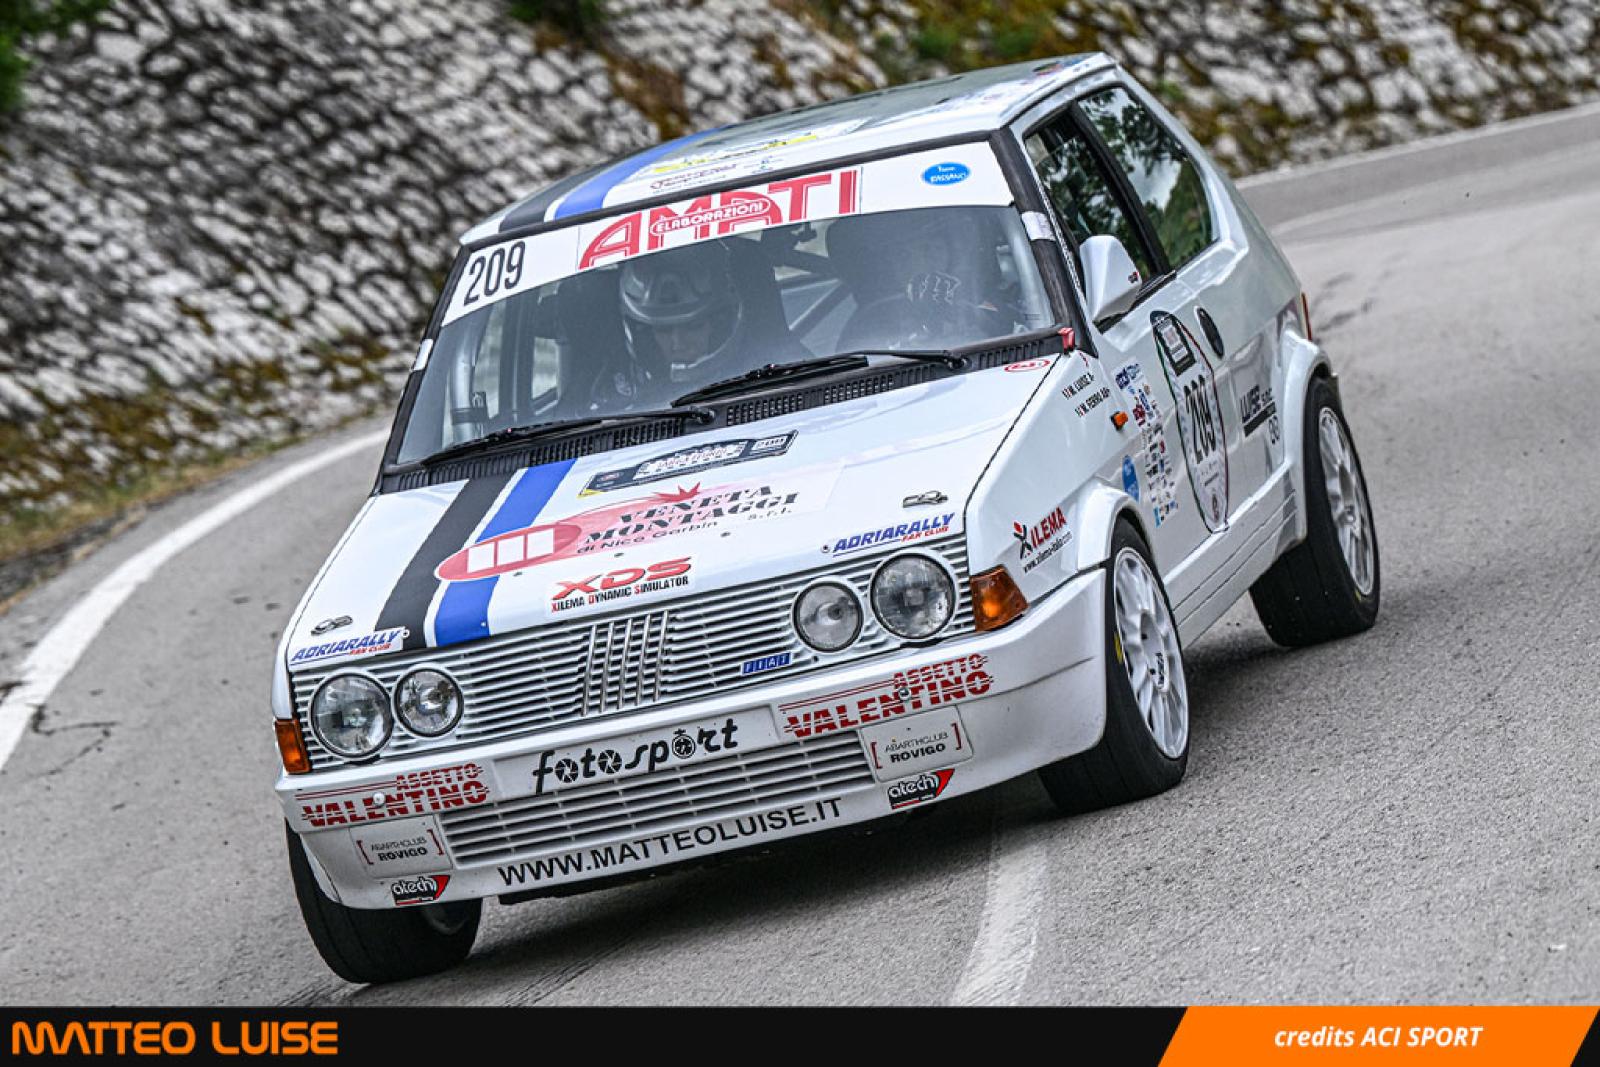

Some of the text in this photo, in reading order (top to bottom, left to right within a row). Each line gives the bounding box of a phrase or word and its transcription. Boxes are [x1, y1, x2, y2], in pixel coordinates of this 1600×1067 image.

[578, 169, 858, 271] AMATI
[655, 202, 764, 234] ELABORAZIONI
[463, 241, 526, 306] 209
[1183, 374, 1217, 464] 209
[585, 492, 798, 545] MONTAGGI
[620, 485, 773, 523] VENETA
[601, 536, 645, 549] Nico
[652, 520, 718, 539] Garbin
[832, 512, 956, 553] ADRIARALLY
[1013, 507, 1067, 559] XILEMA
[550, 556, 692, 601] XDS
[551, 575, 690, 613] XILEMA DYNAMIC SIMULATOR
[291, 630, 400, 662] ADRIARALLY
[742, 652, 790, 674] FIAT
[892, 653, 990, 690] ASSETTO
[783, 671, 994, 737] VALENTINO
[890, 743, 946, 763] ROVIGO
[395, 762, 485, 792] ASSETTO
[301, 779, 491, 827] VALENTINO
[378, 847, 428, 861] ROVIGO
[497, 797, 842, 887] WWW.MATTEOLUISE.IT
